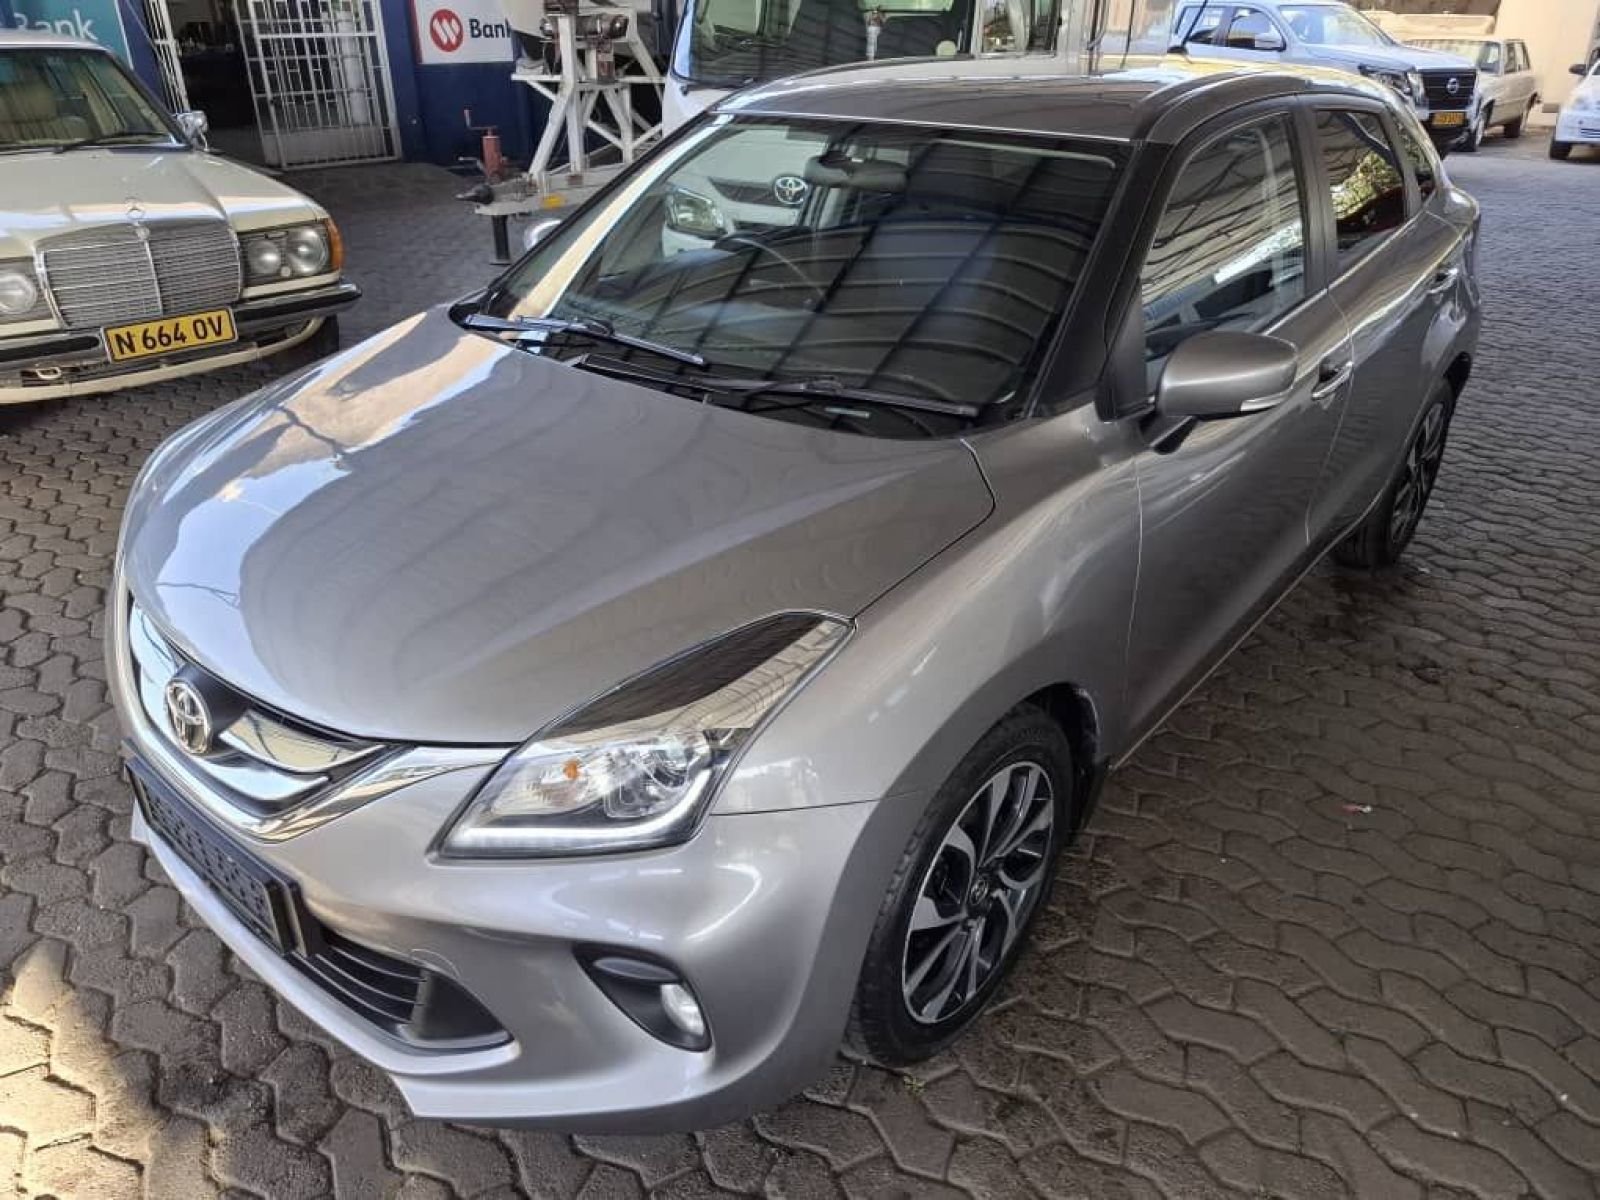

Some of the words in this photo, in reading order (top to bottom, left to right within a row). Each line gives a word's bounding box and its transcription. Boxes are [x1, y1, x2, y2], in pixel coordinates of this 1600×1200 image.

[114, 330, 136, 355] N
[141, 322, 188, 350] 664
[192, 314, 222, 340] OV
